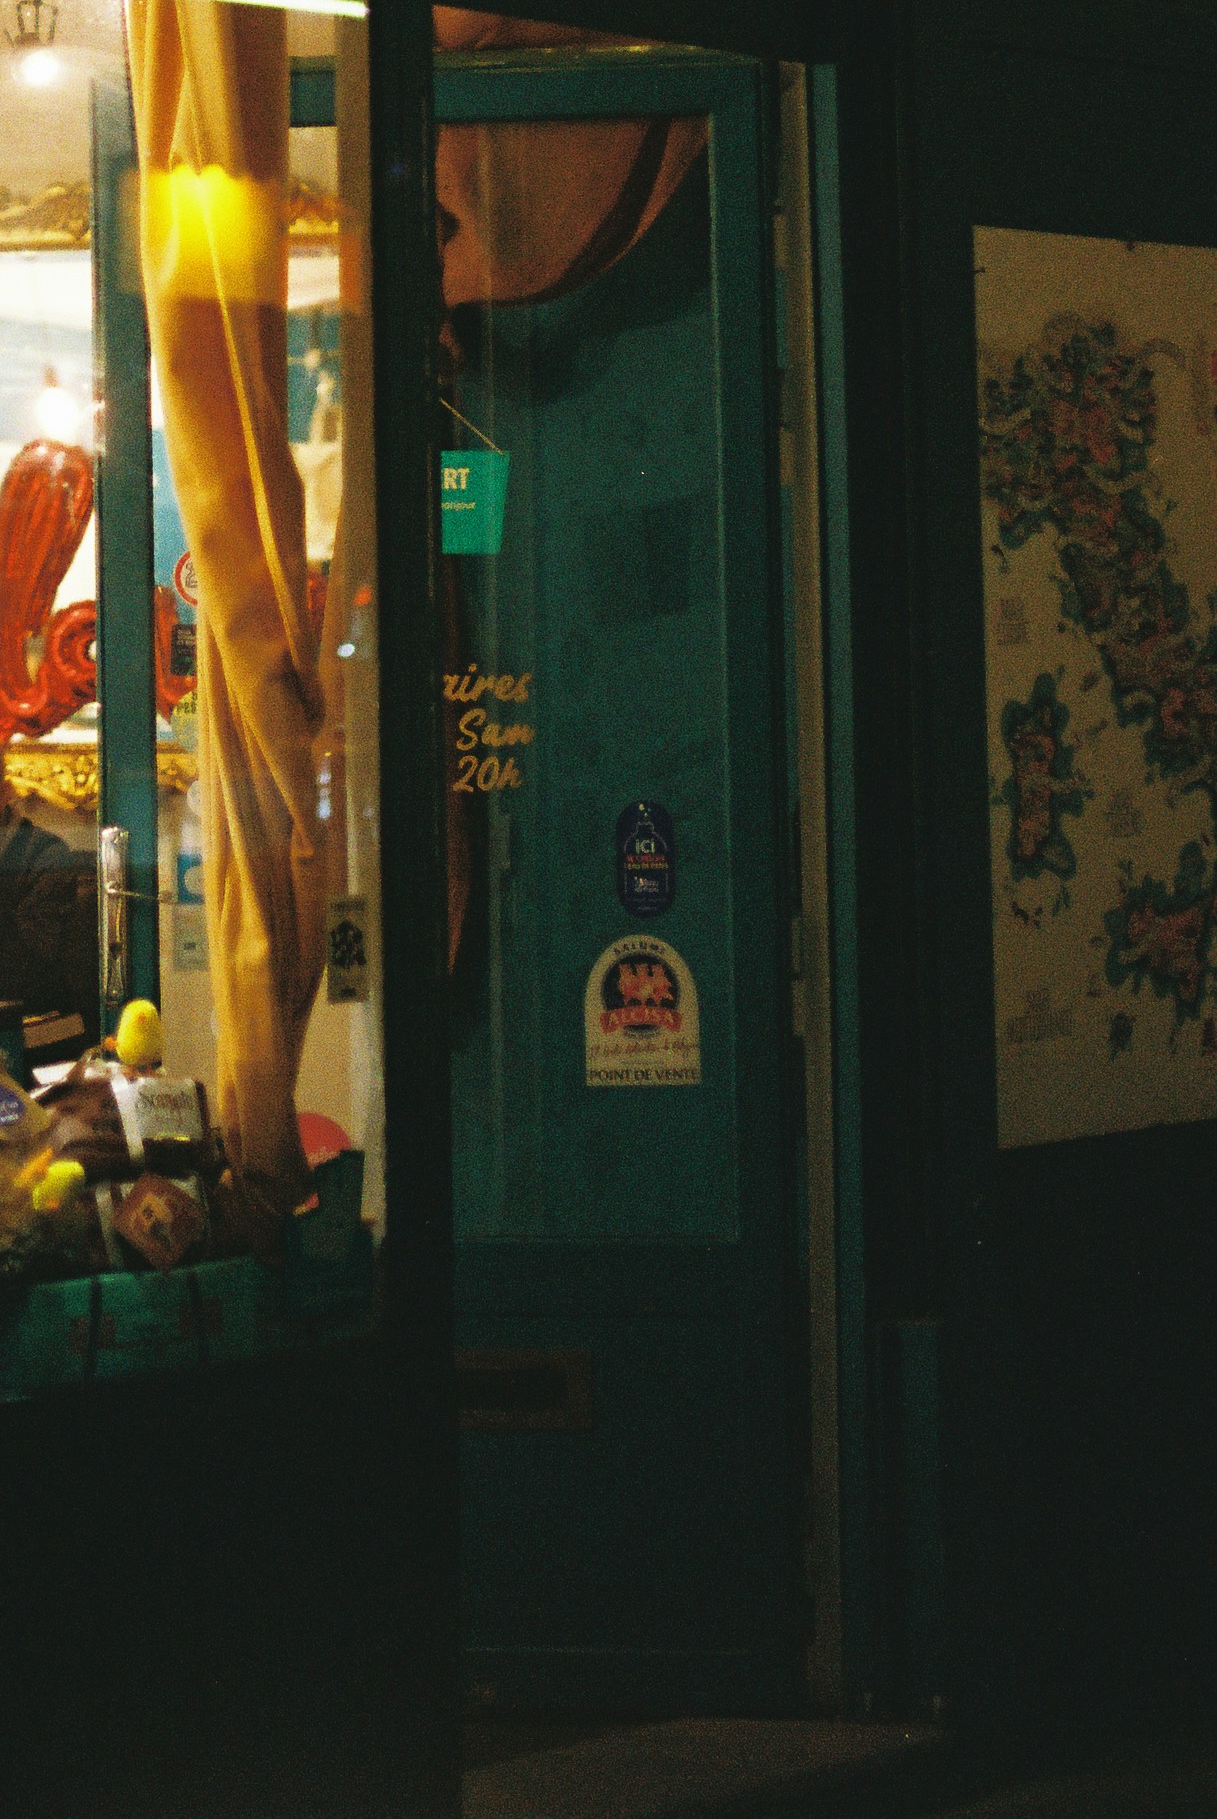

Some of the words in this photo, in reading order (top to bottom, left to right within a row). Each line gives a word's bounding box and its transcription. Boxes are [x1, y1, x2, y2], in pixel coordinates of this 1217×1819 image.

[452, 755, 524, 794] 20h
[589, 1069, 632, 1081] POINT
[634, 1069, 652, 1081] DE
[654, 1068, 699, 1081] VENTE
